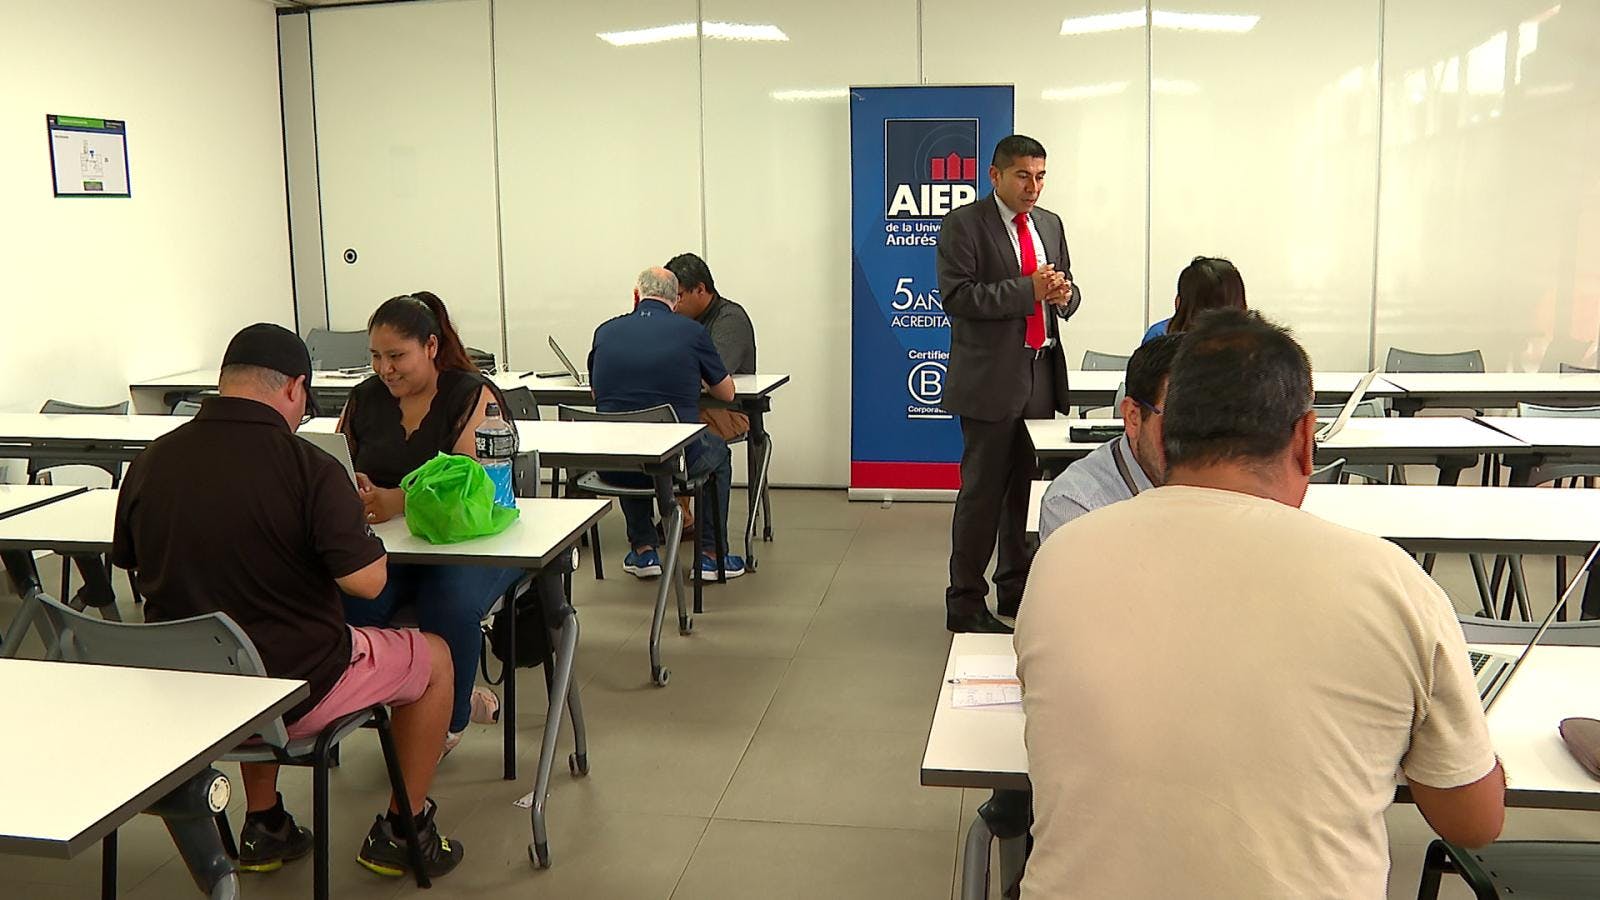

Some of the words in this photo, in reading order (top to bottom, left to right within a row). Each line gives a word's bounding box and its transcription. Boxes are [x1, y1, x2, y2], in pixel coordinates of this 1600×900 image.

[887, 184, 976, 216] AIEP
[885, 223, 899, 232] de
[902, 223, 912, 232] la
[886, 233, 937, 246] Andrés
[891, 278, 914, 310] 5
[913, 289, 944, 311] AÑ
[891, 315, 952, 328] ACREDITA
[920, 369, 942, 396] B
[908, 405, 947, 414] Corpora
